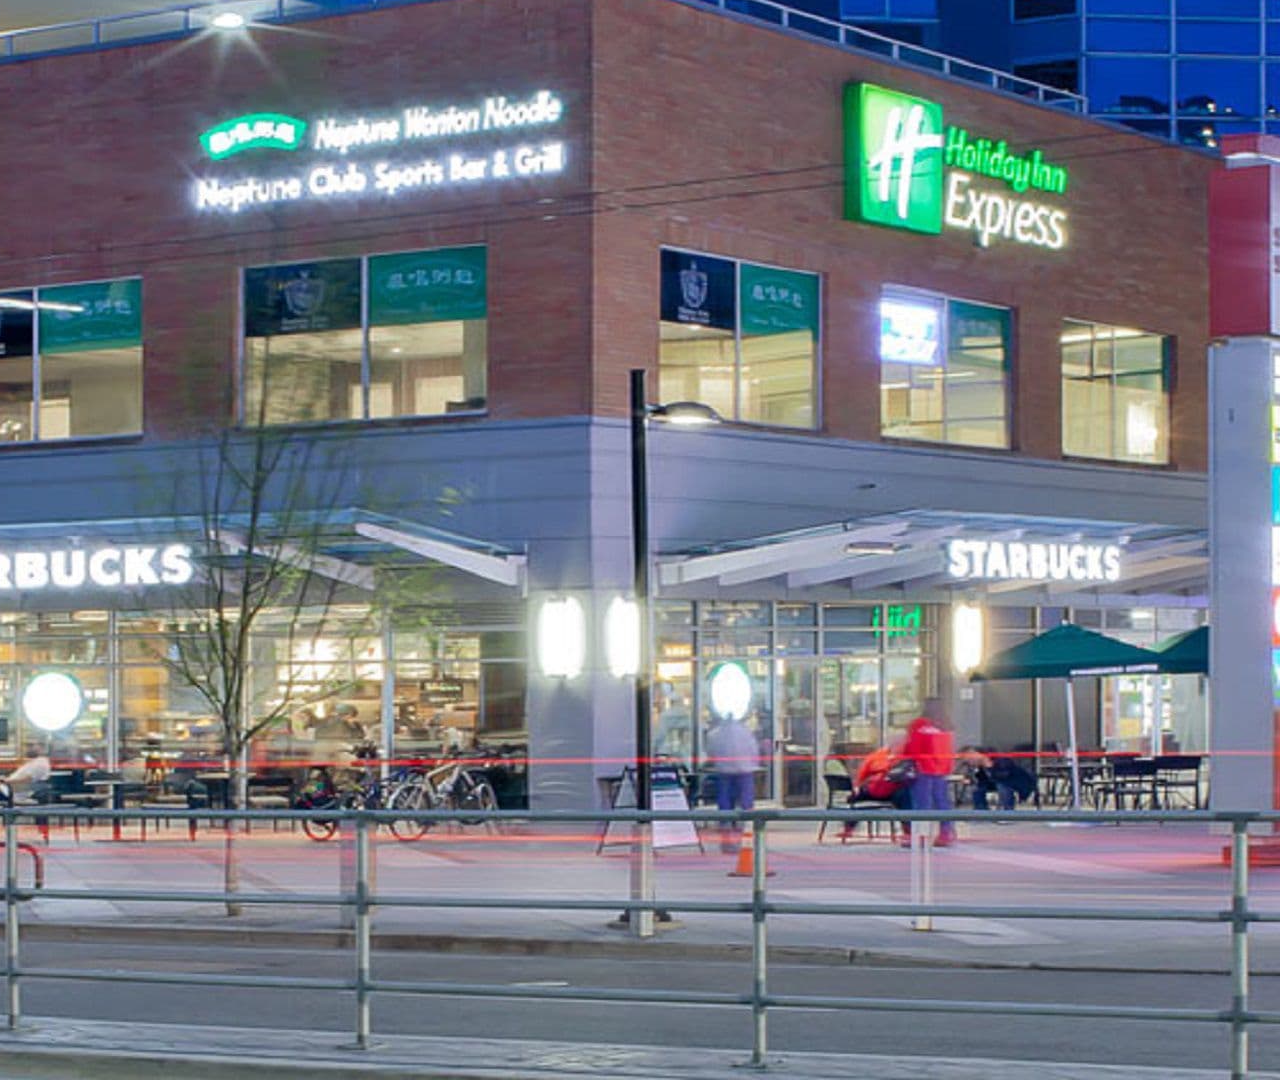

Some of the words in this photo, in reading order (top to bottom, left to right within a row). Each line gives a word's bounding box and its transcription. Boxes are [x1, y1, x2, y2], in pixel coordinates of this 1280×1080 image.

[315, 119, 399, 153] Neptune
[404, 106, 478, 139] Wonton
[484, 91, 562, 129] Noodle
[197, 177, 301, 210] Neptune
[308, 166, 368, 196] Club
[374, 161, 443, 195] Sports
[449, 155, 487, 181] Bar
[492, 150, 509, 177] &
[514, 142, 564, 173] Grill
[945, 125, 1031, 193] Holiday
[1031, 149, 1068, 195] Inn
[945, 172, 1068, 250] Express
[948, 539, 1121, 582] STARBUCKS
